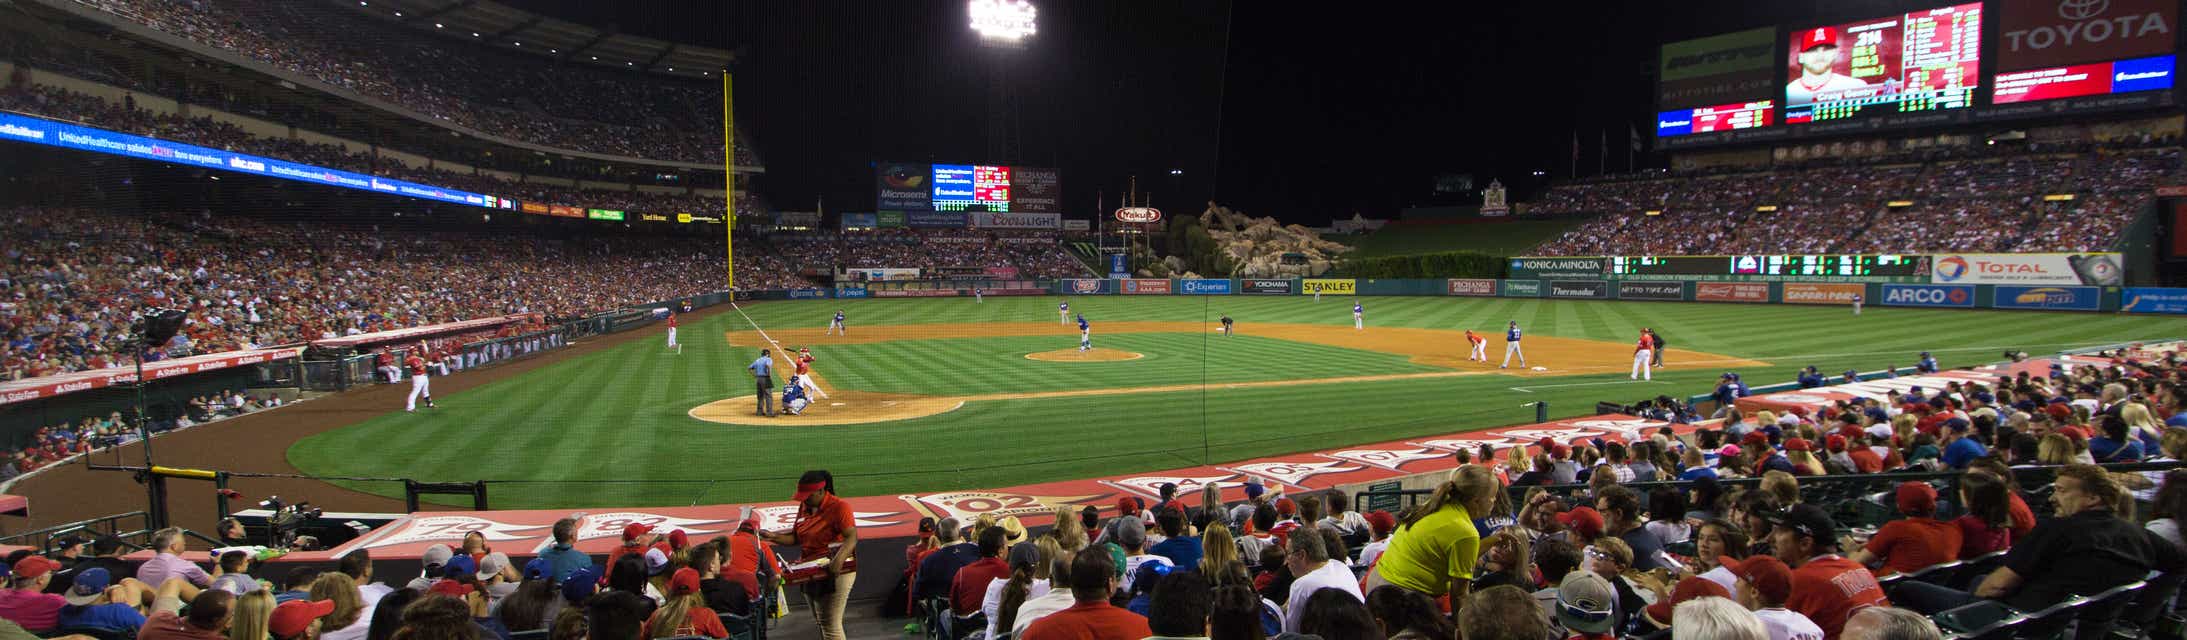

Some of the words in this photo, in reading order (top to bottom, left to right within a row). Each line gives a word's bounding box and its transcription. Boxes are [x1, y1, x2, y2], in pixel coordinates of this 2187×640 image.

[2005, 13, 2168, 51] TOYOTA
[881, 190, 927, 199] Microsemi
[1123, 210, 1154, 220] Yakut
[1026, 217, 1057, 227] LIGHT
[1523, 260, 1558, 270] KONICA
[1559, 260, 1600, 270] MINOLTA
[1254, 281, 1288, 289] YOKOHAMA
[1304, 282, 1354, 291] STANLEY
[846, 289, 865, 298] pepsi
[1553, 287, 1595, 296] Thermador
[1788, 291, 1827, 300] SAFARI
[1886, 289, 1946, 303] ARCO
